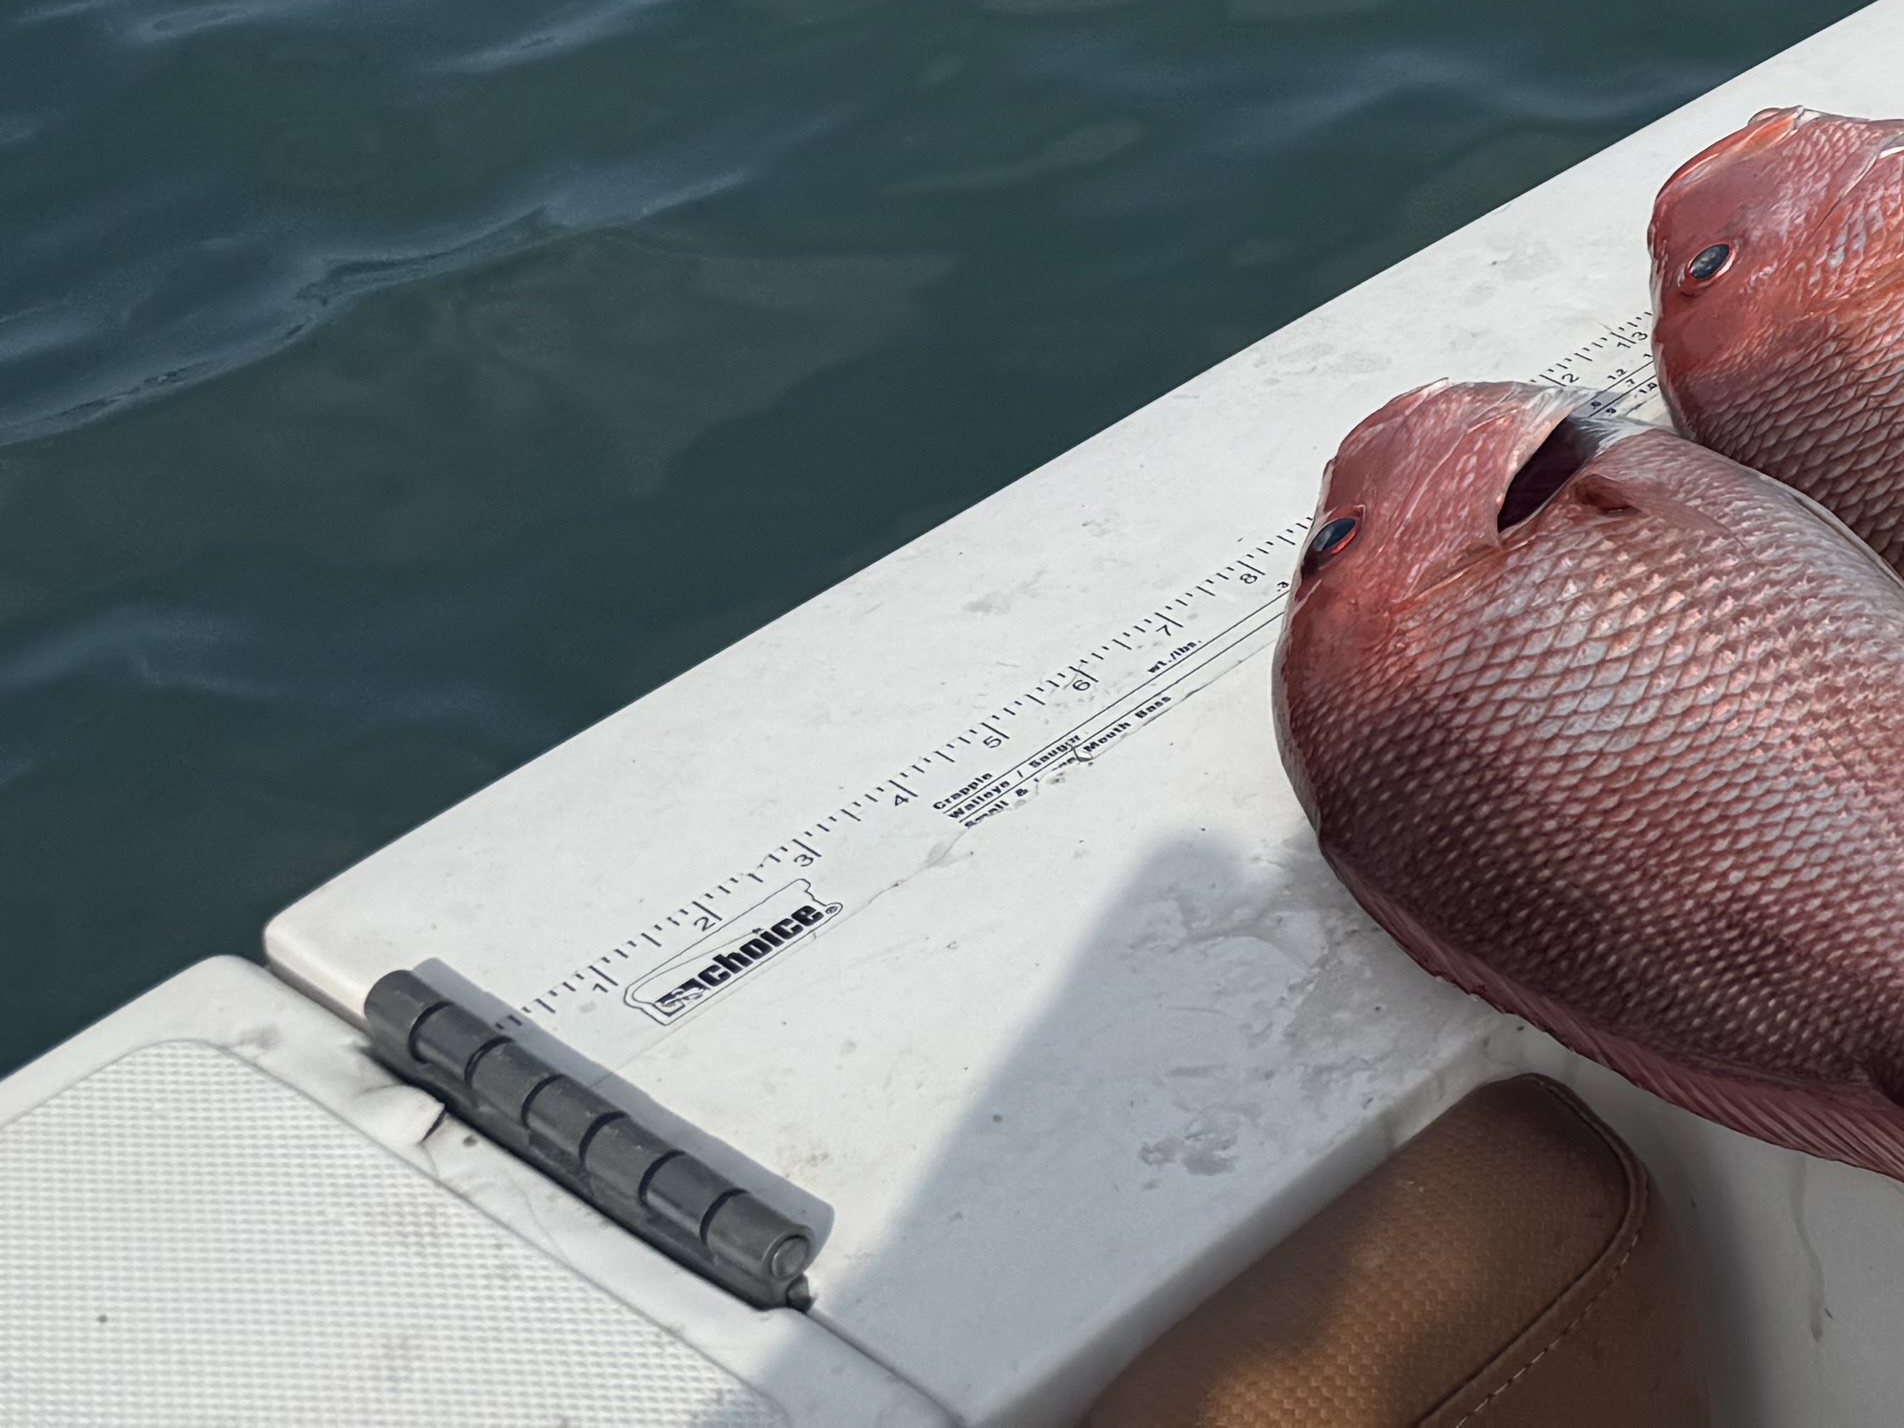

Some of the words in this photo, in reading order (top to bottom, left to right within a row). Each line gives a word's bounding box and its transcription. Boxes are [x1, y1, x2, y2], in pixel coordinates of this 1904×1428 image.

[1616, 331, 1648, 349] 13
[1083, 722, 1131, 753] Mouth
[1134, 696, 1172, 719] Bass
[593, 982, 608, 993] 1
[693, 916, 715, 931] 2
[793, 854, 814, 867] 3
[894, 794, 909, 806] 4
[983, 735, 1002, 748] 5
[1072, 679, 1091, 691] 6
[1156, 624, 1171, 636] 7
[1239, 573, 1258, 584] 8
[948, 780, 1010, 819] Walleye
[698, 905, 824, 986] choice
